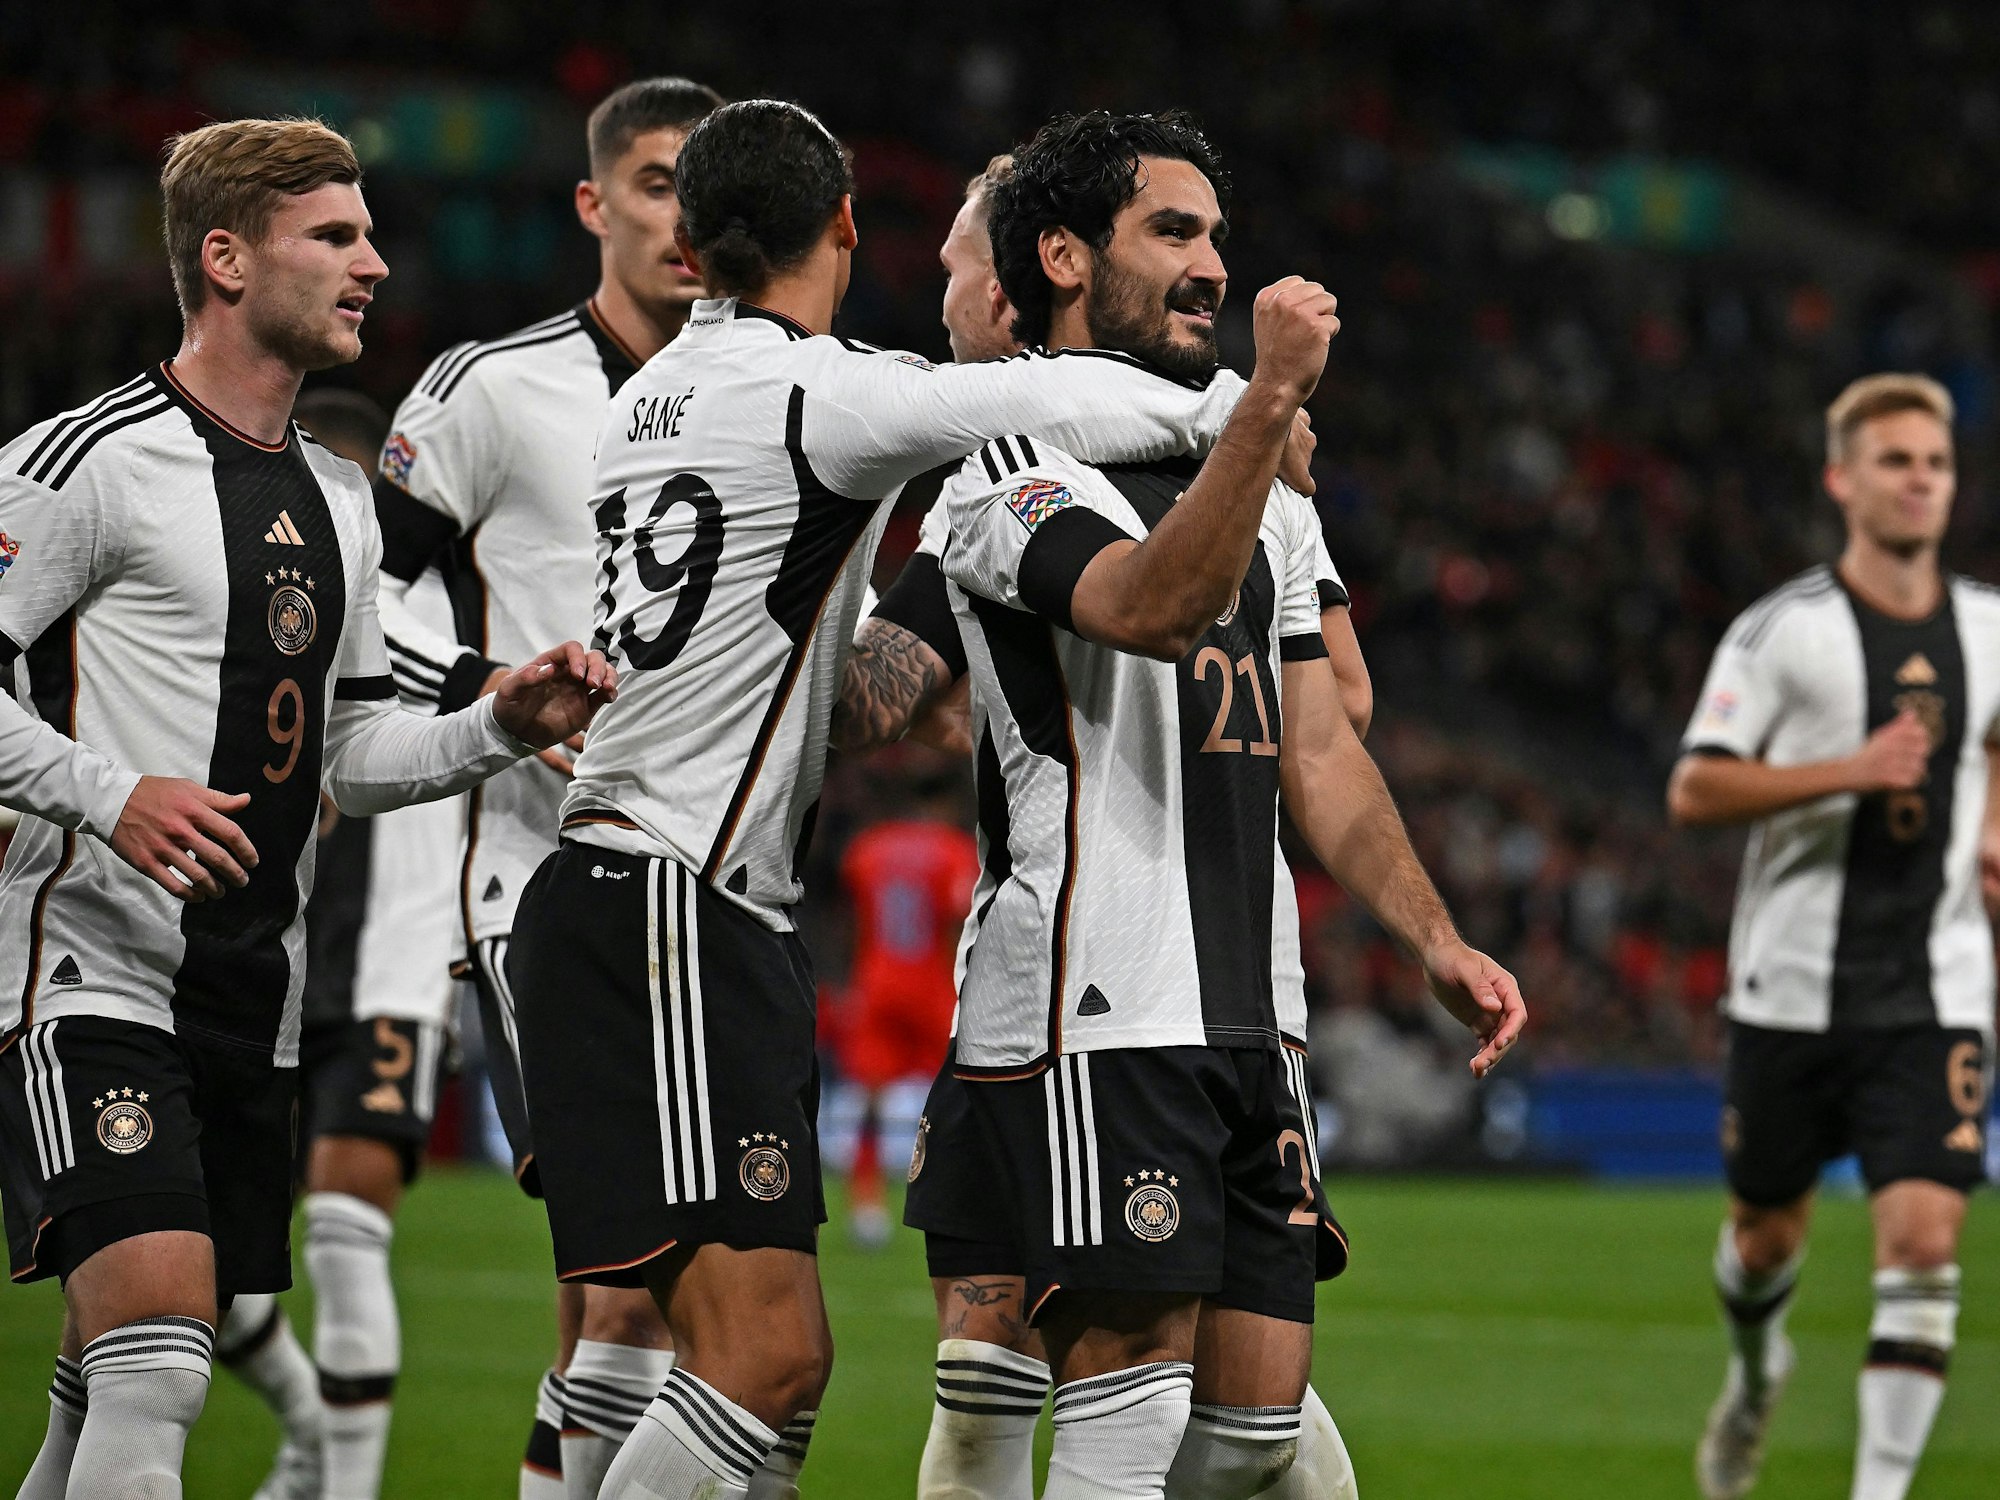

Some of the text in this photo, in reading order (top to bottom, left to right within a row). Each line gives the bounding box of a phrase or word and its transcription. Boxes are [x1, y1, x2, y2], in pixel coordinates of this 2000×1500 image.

[627, 386, 695, 442] SANÉ
[594, 473, 728, 671] 19
[262, 678, 305, 784] 9
[1194, 646, 1278, 757] 21
[369, 1015, 413, 1079] 5
[1945, 1039, 1985, 1118] 6
[107, 1108, 140, 1121] DEUTSCHER
[1137, 1191, 1168, 1203] DEUTSCHER
